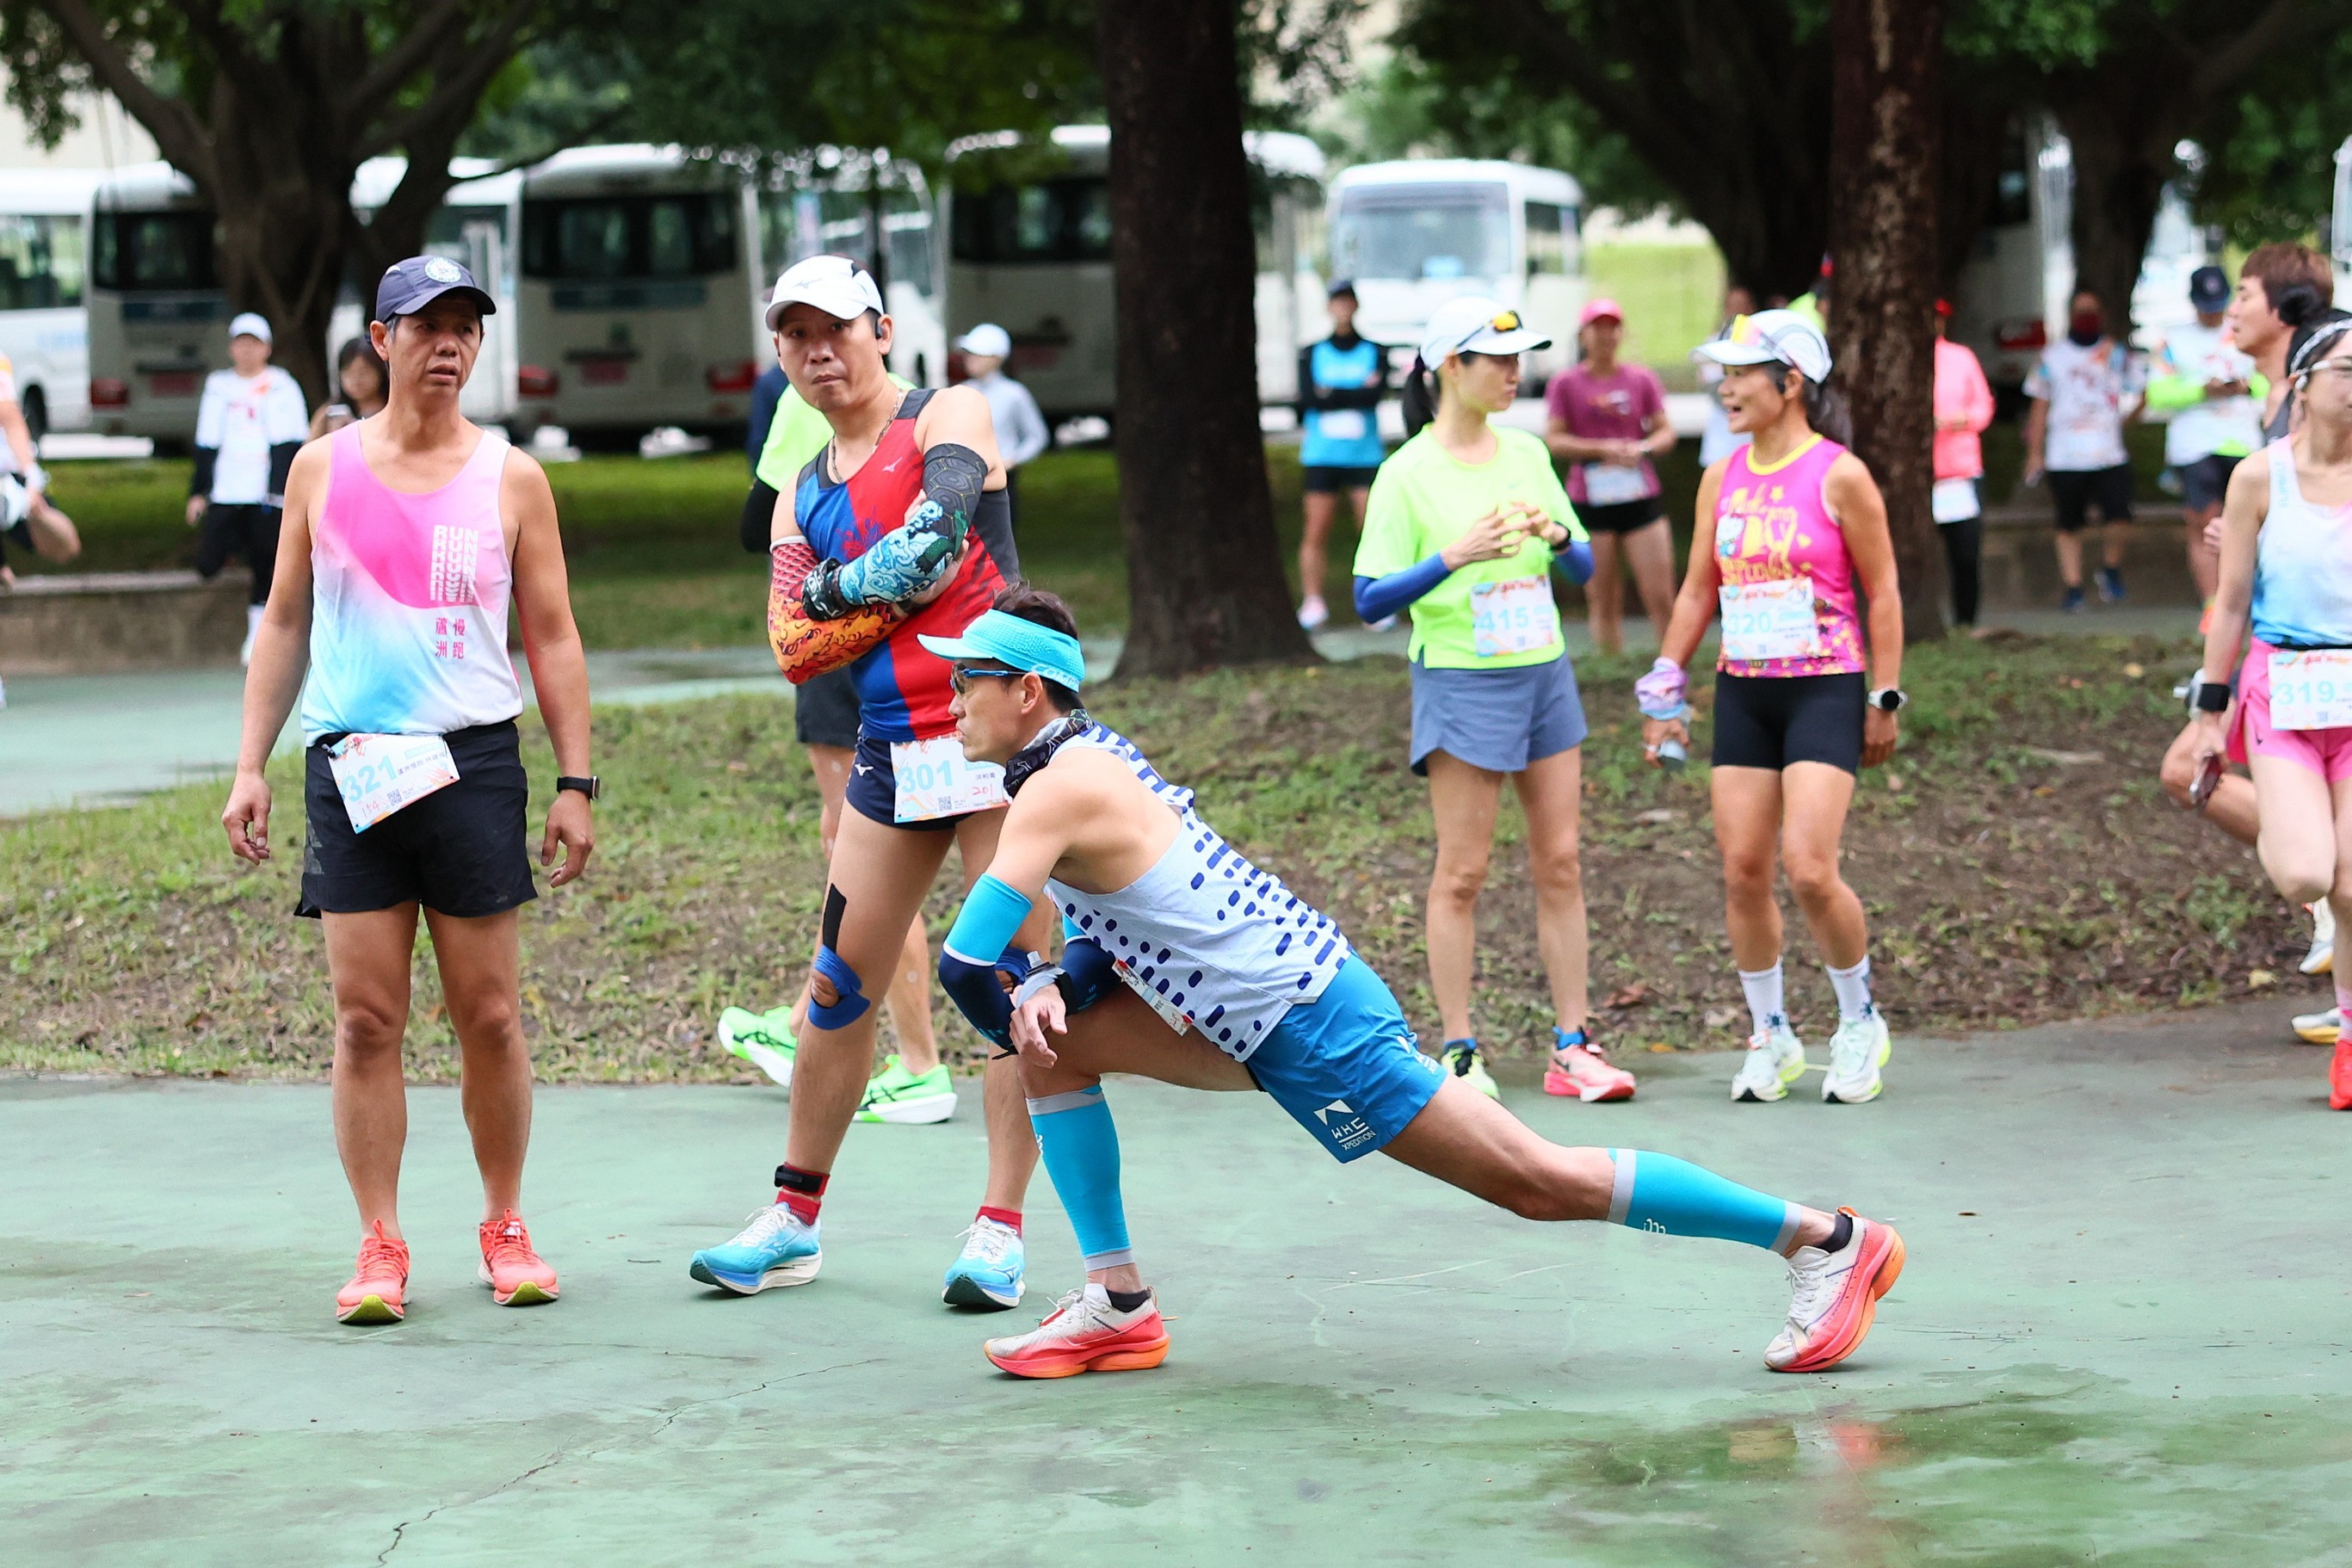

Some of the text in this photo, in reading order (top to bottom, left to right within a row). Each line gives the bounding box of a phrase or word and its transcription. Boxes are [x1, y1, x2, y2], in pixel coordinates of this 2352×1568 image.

[434, 525, 479, 543] RUN
[1474, 606, 1528, 632] 415
[1725, 611, 1772, 635] 320
[2276, 680, 2336, 705] 319
[343, 755, 398, 802] 321
[900, 759, 954, 793] 301
[972, 783, 993, 798] 201
[1331, 1117, 1366, 1139] WHC
